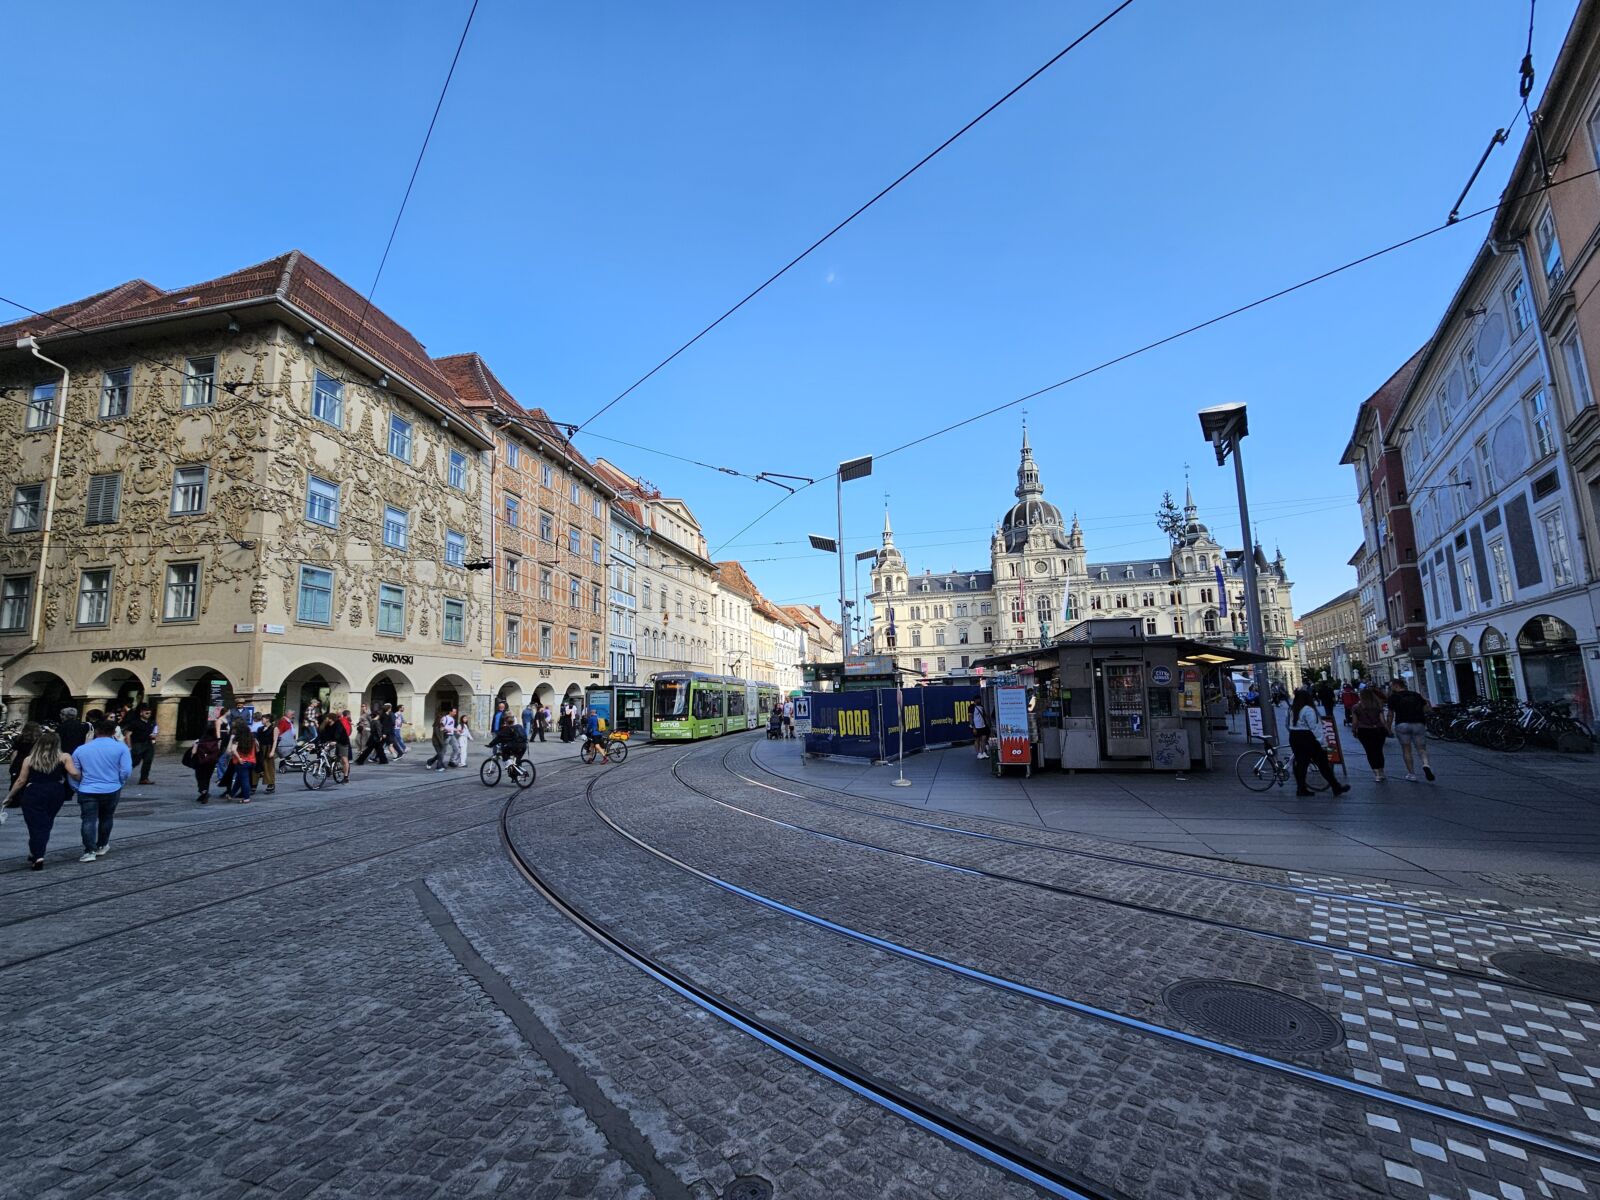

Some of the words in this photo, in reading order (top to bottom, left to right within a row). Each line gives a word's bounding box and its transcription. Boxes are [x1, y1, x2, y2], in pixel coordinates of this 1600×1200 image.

[91, 649, 146, 663] SWAROVSKI
[372, 653, 413, 665] SWAROVSKI
[954, 701, 974, 724] POR
[839, 710, 870, 737] PORR
